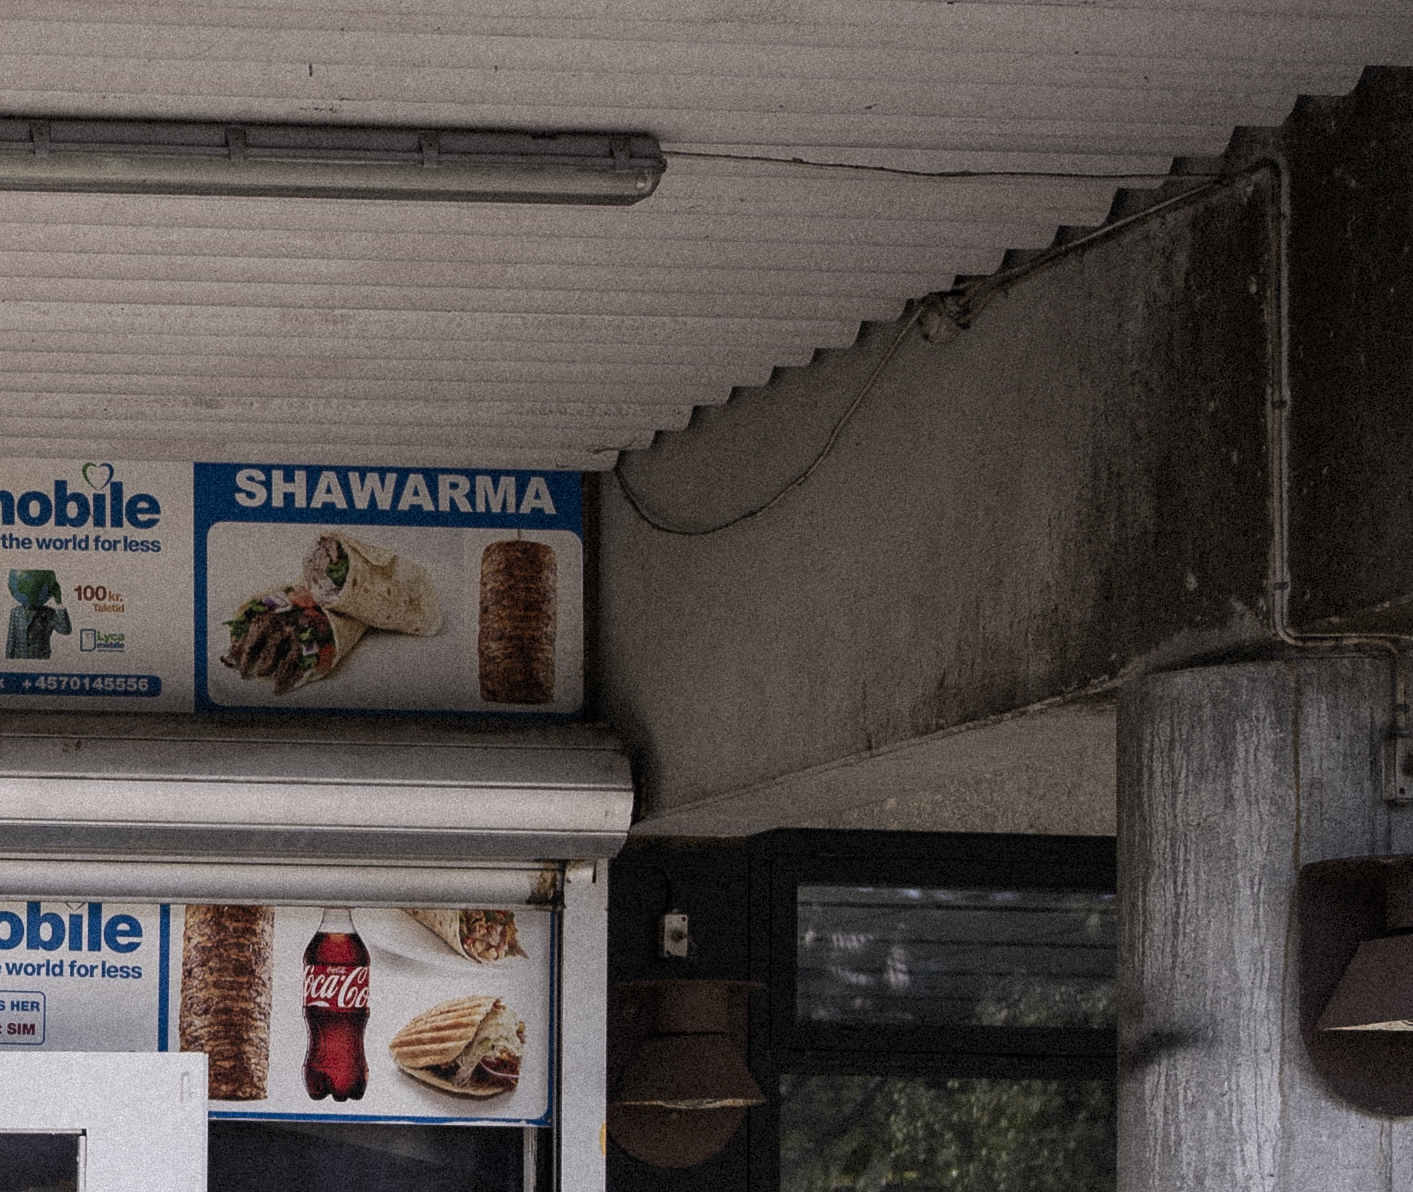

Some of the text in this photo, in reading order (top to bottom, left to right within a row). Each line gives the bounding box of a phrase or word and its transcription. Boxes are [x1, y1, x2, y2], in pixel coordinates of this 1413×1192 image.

[234, 468, 558, 515] SHAWARMA
[1, 533, 33, 550] the
[36, 535, 89, 551] world
[93, 535, 121, 552] for
[123, 536, 162, 553] less
[74, 585, 124, 602] 100 kr.
[97, 631, 125, 643] Lyca
[23, 676, 149, 692] +4570145556
[5, 959, 64, 977] world
[69, 960, 98, 977] for
[101, 961, 143, 979] less
[10, 1001, 40, 1012] HER
[7, 1022, 35, 1036] SIM
